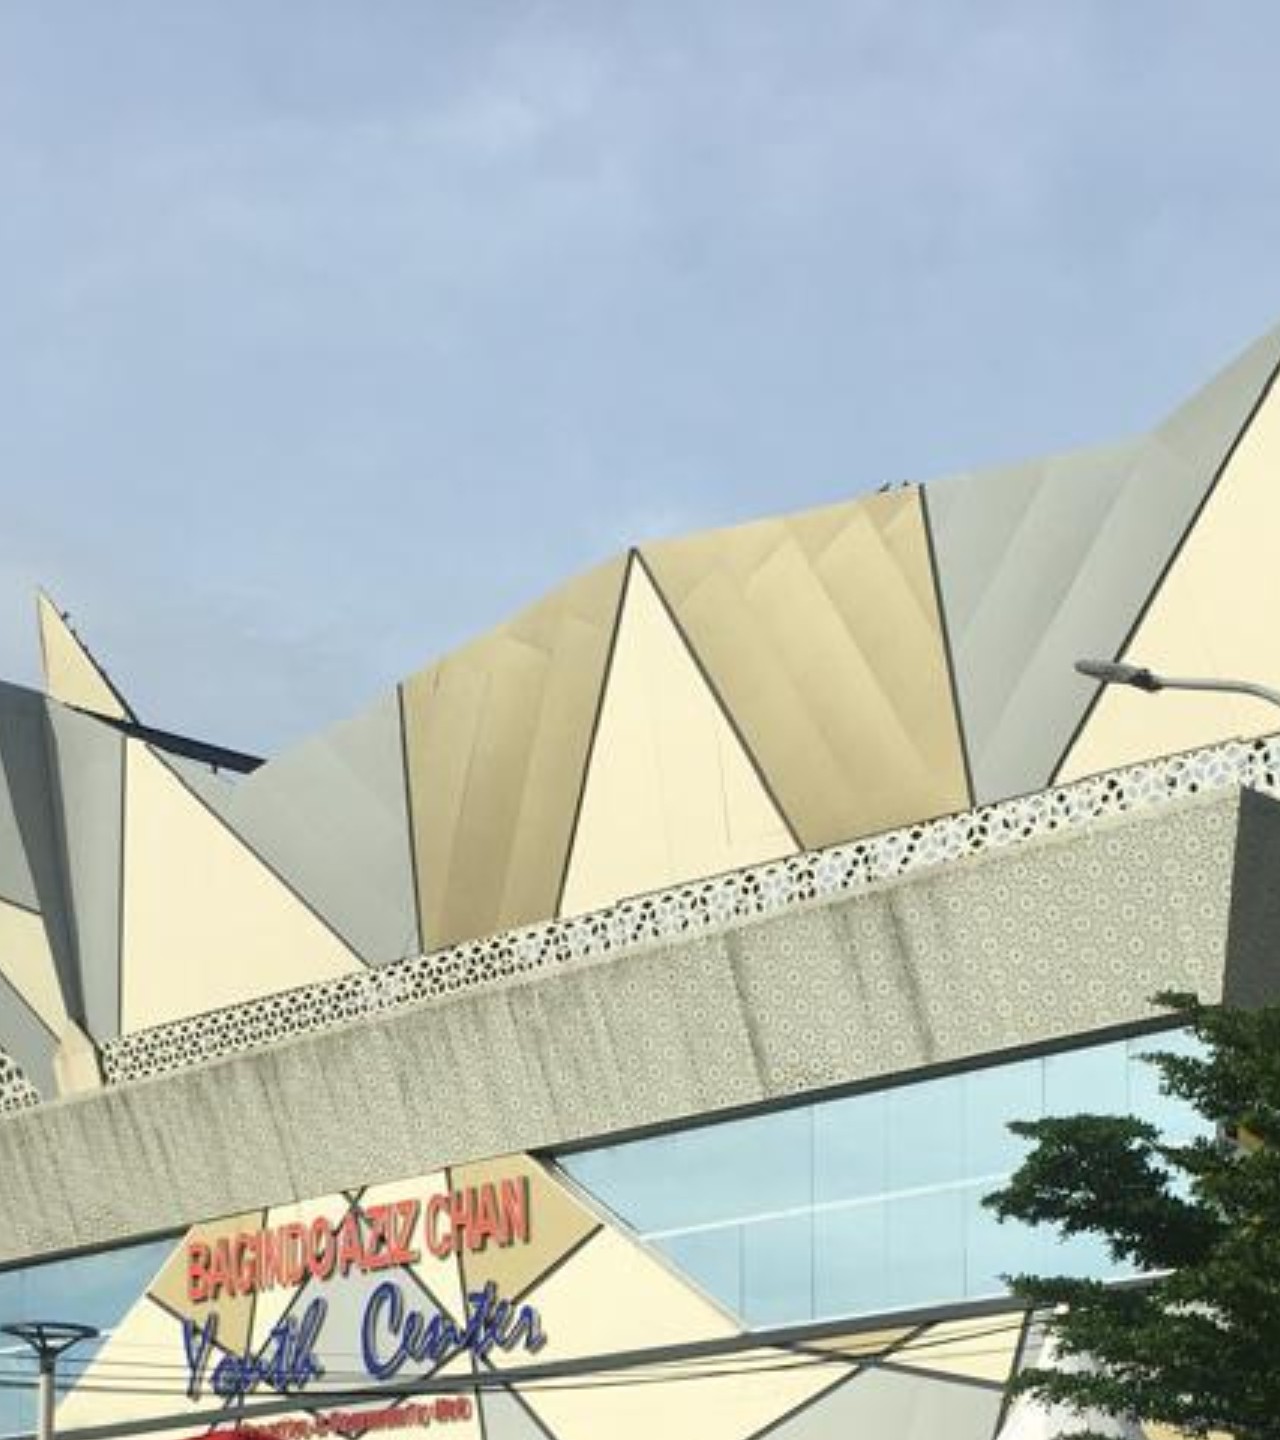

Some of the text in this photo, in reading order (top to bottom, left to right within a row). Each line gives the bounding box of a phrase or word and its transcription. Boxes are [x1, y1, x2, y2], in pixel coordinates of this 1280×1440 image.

[187, 1175, 532, 1304] BAGINDO AZIZ CHAN
[181, 1278, 549, 1402] Youth Center
